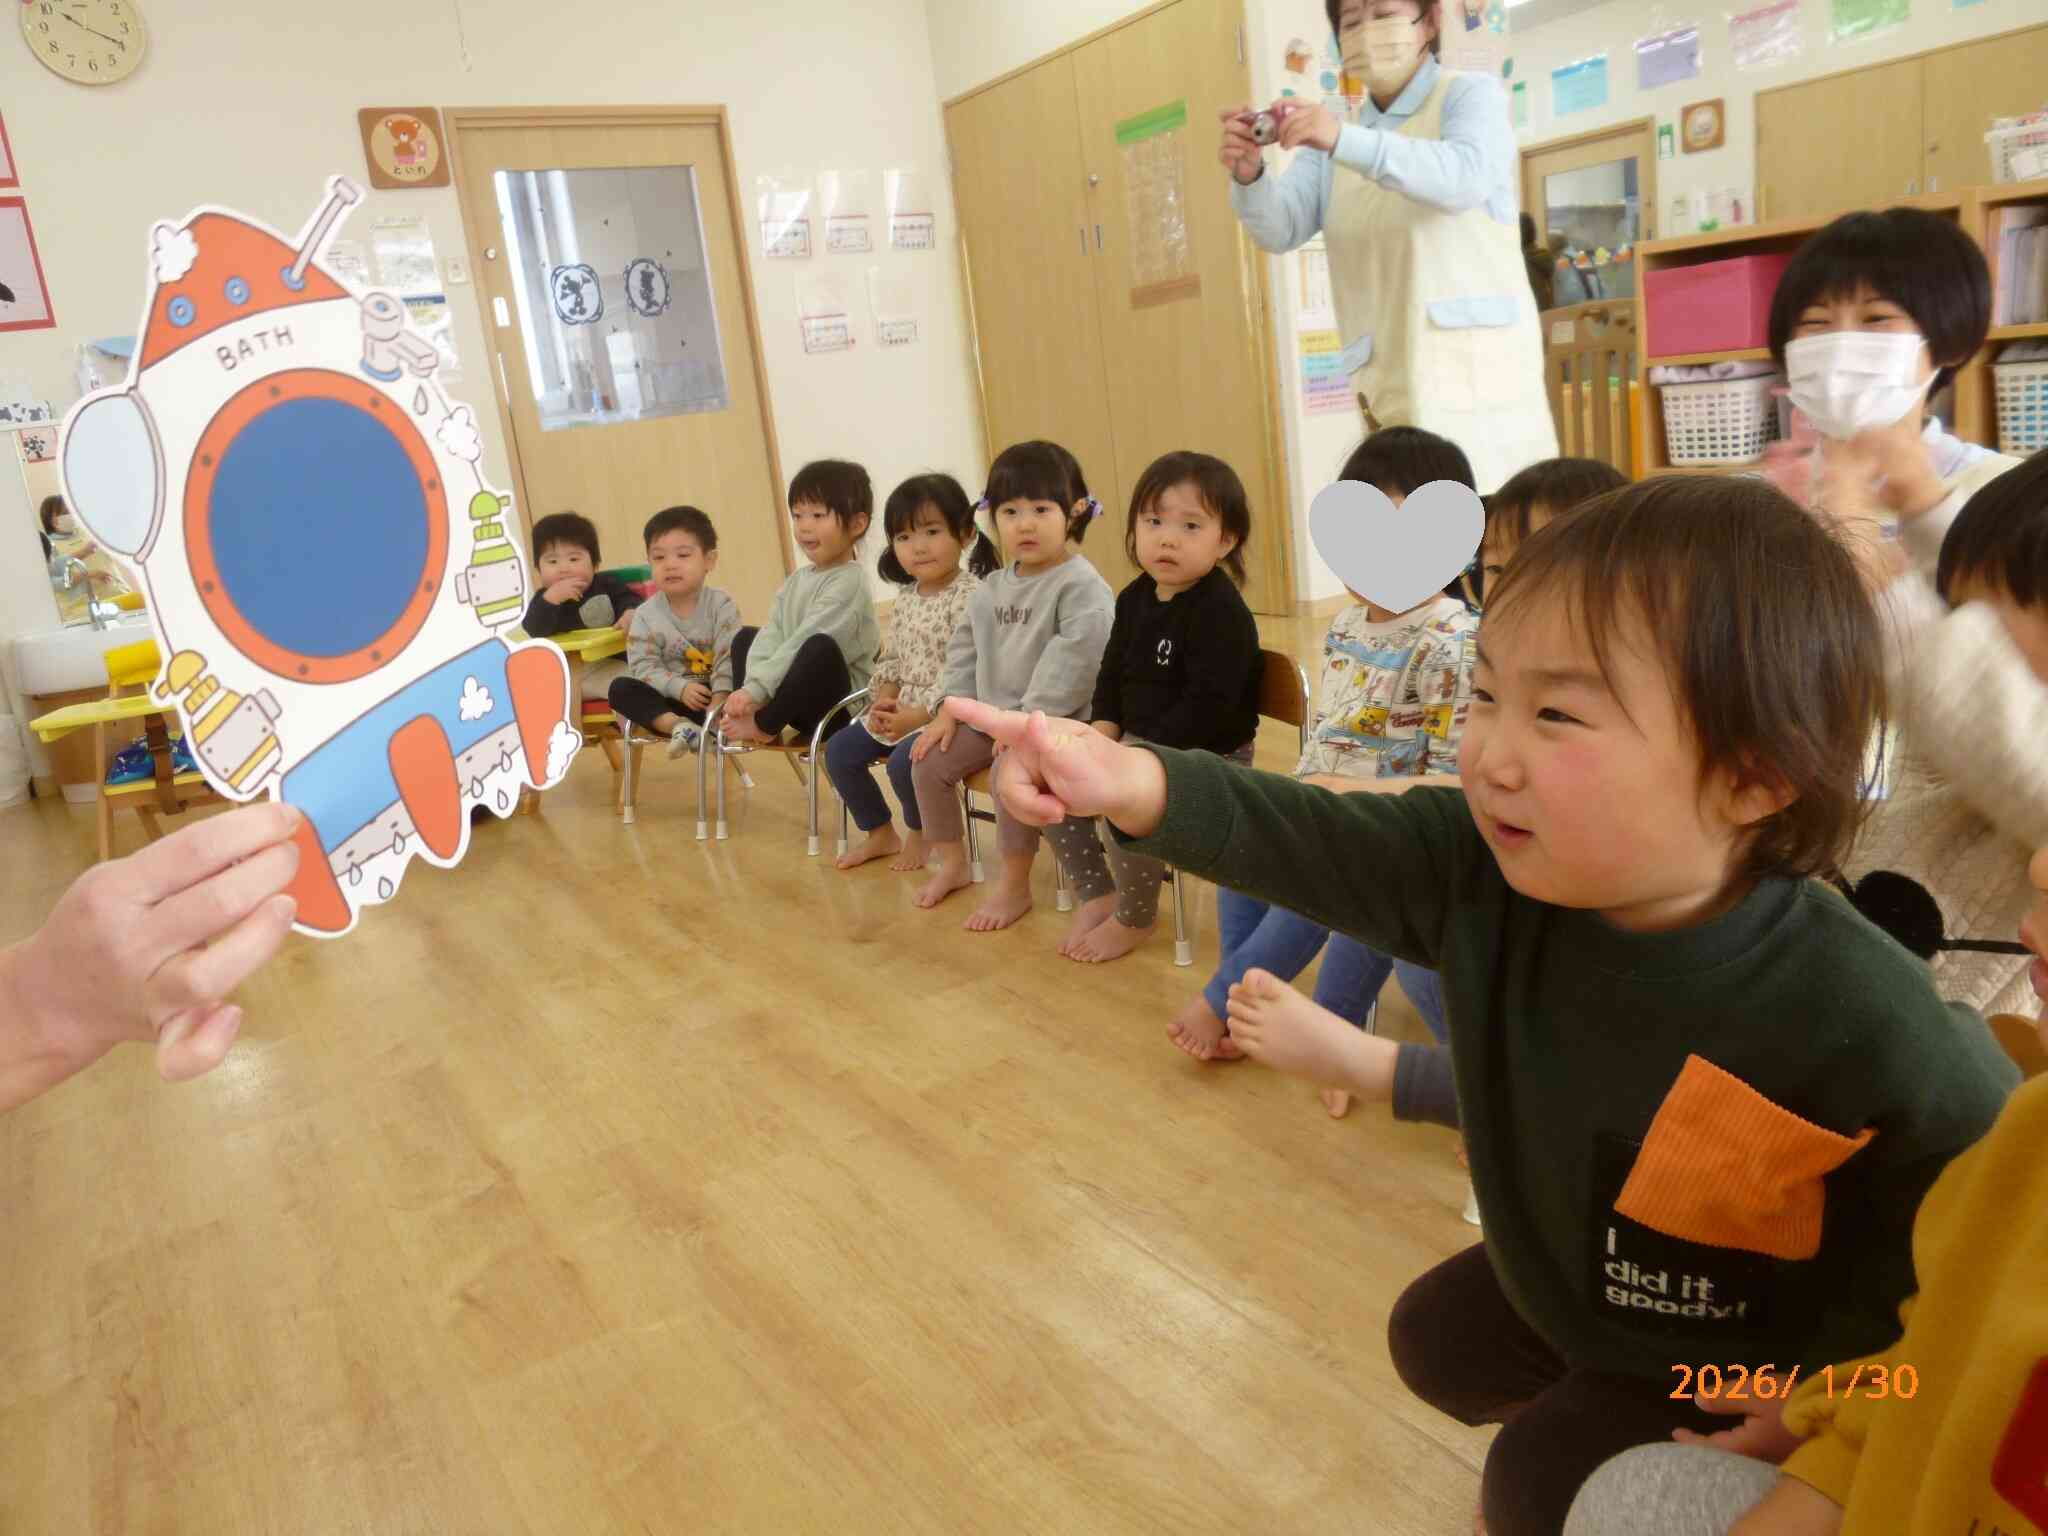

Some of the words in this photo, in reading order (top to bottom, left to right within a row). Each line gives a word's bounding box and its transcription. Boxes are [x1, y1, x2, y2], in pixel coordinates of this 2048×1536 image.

[110, 2, 121, 15] 2
[39, 21, 49, 33] 9
[119, 21, 129, 34] 3
[48, 40, 59, 53] 8
[66, 53, 76, 67] 7
[88, 59, 98, 72] 6
[107, 54, 117, 66] 5
[216, 324, 294, 370] BATH
[1607, 1226, 1617, 1256] I
[1604, 1259, 1668, 1295] did
[1681, 1274, 1715, 1301] it
